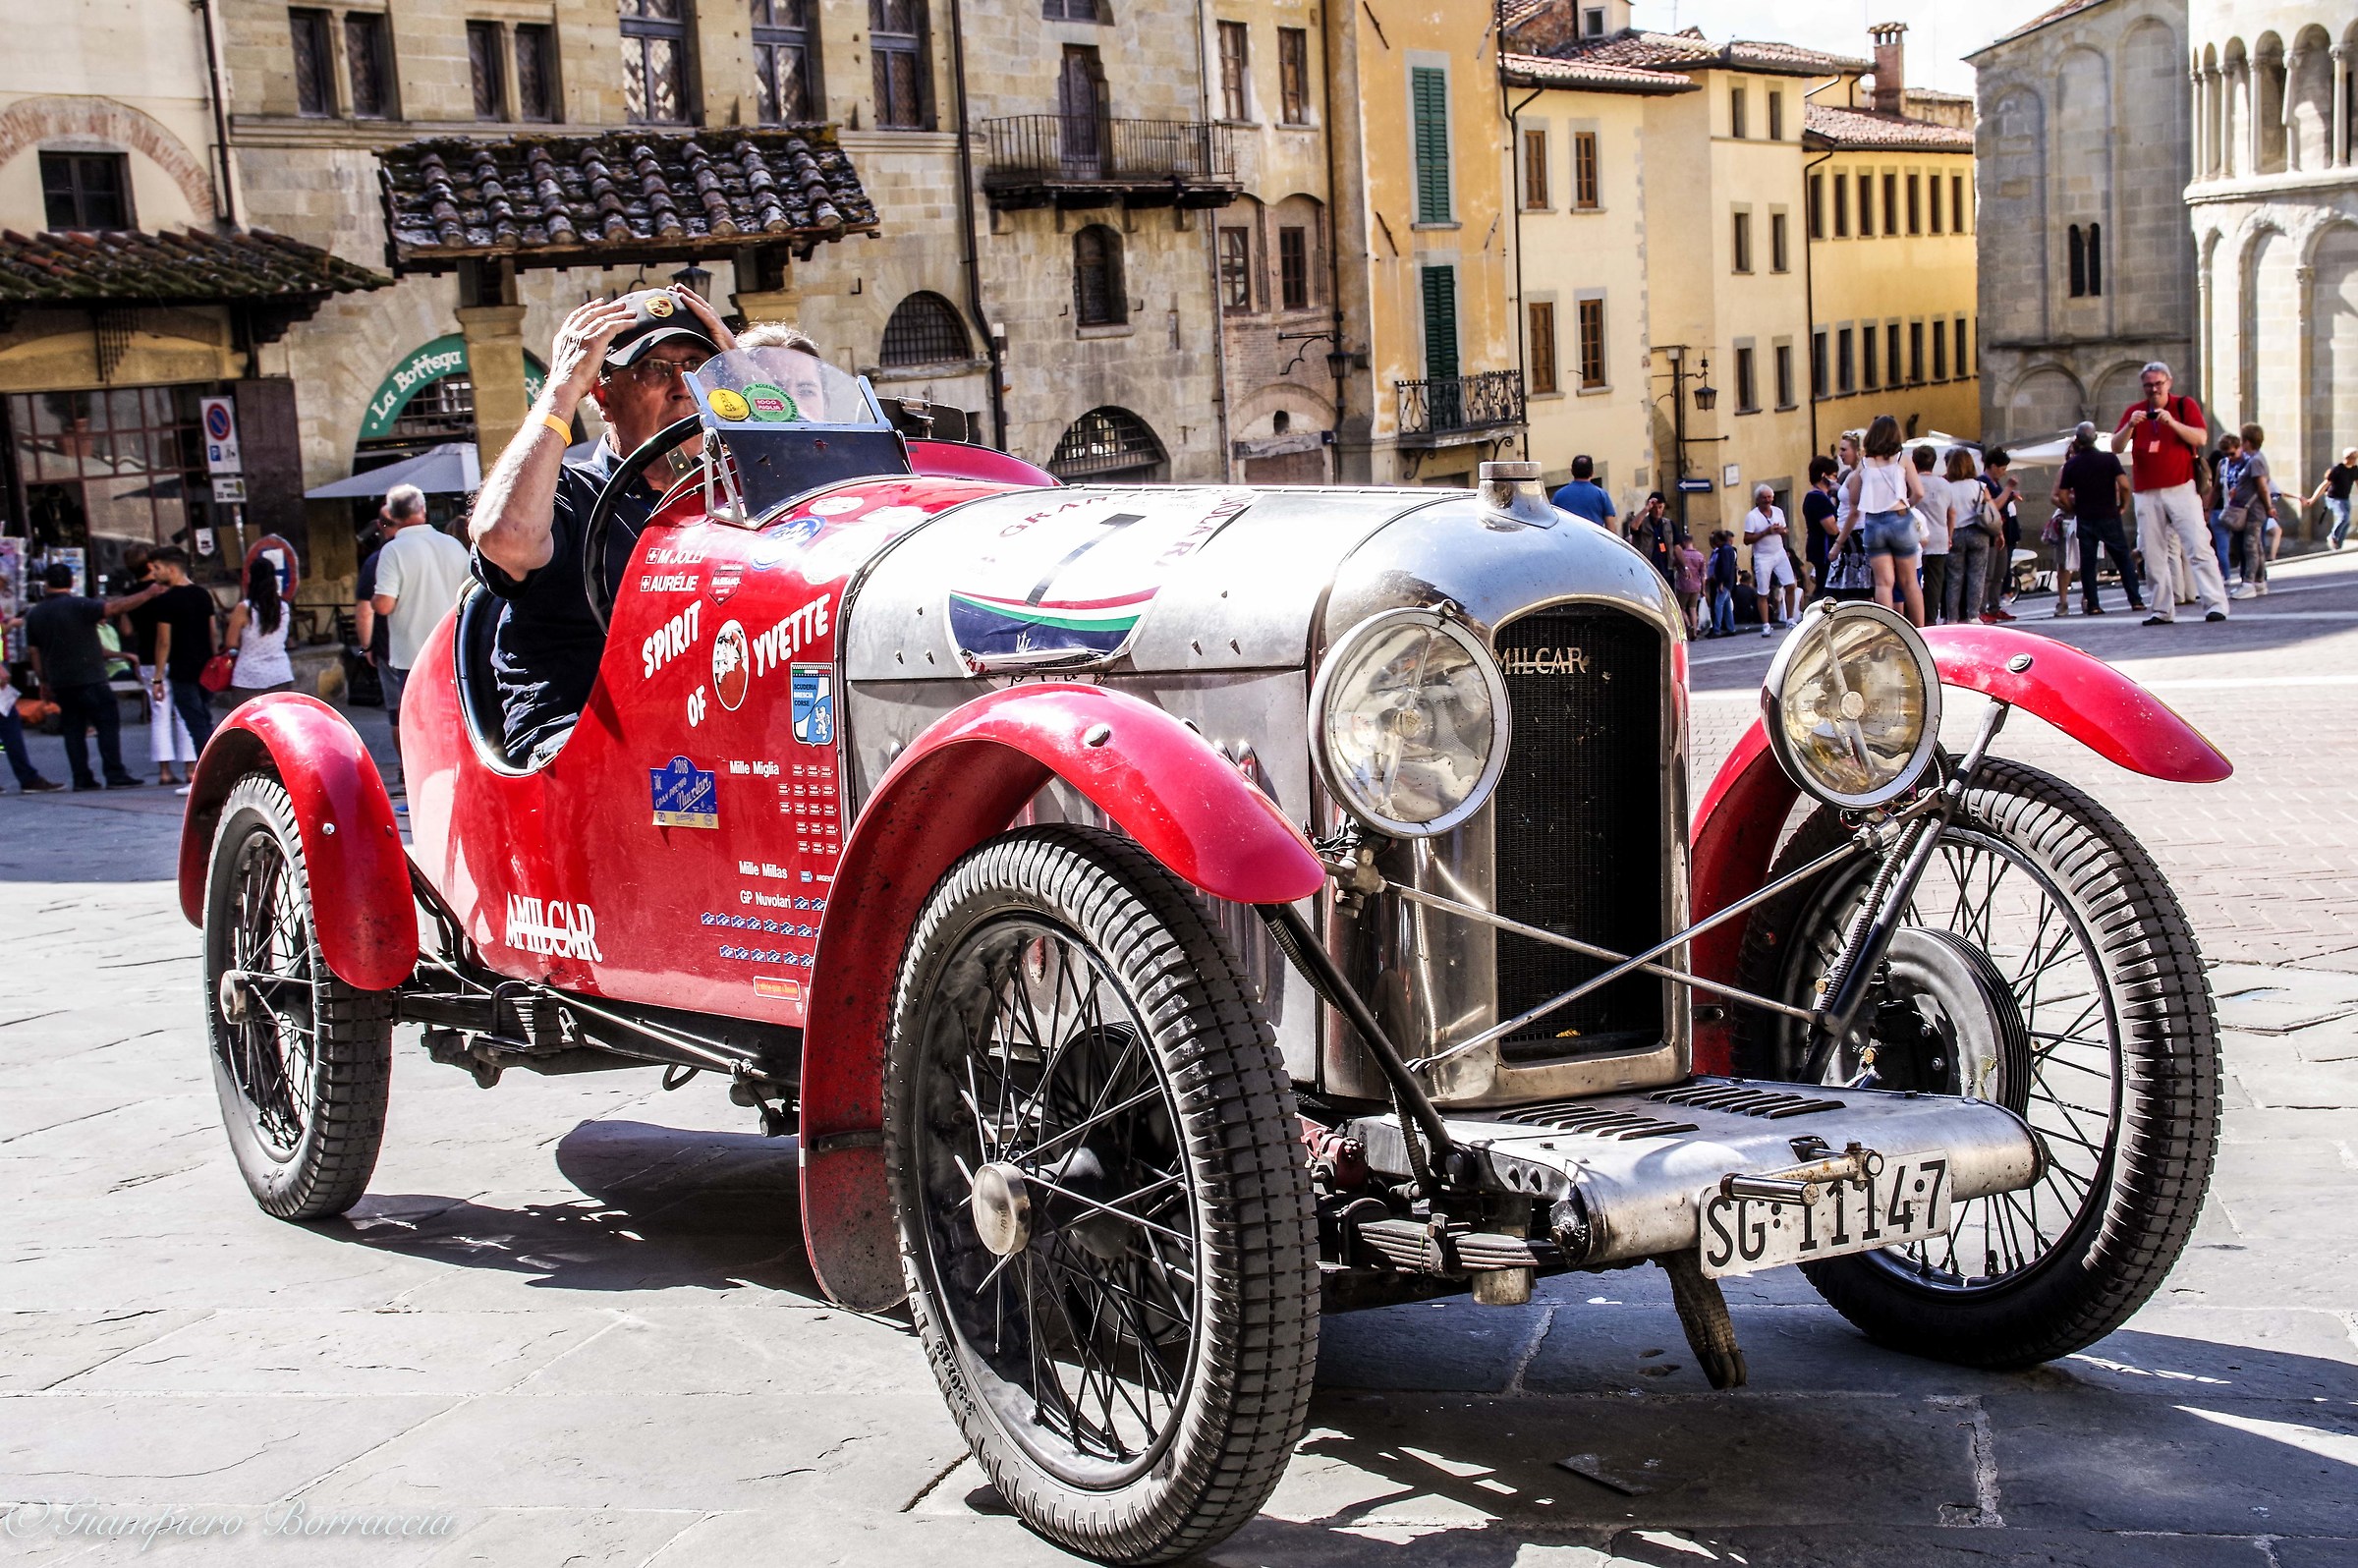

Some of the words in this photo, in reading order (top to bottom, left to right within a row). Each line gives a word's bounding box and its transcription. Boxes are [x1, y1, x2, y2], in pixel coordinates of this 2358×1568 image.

[370, 390, 398, 420] La
[393, 351, 462, 393] Bottega
[657, 549, 673, 564] M
[669, 549, 709, 565] JOLLY
[649, 571, 700, 592] AURÉLIE
[642, 599, 702, 679] SPIRIT
[752, 592, 831, 678] YVETTE
[1493, 646, 1590, 675] MILCAR
[688, 685, 706, 728] OF
[674, 759, 689, 774] 2018
[729, 760, 751, 775] Mille
[753, 760, 780, 778] Miglia
[739, 861, 759, 876] Mille
[761, 863, 788, 879] Millas
[740, 889, 754, 904] GP
[756, 891, 792, 909] Nuvolari
[505, 891, 603, 963] AMILCAR
